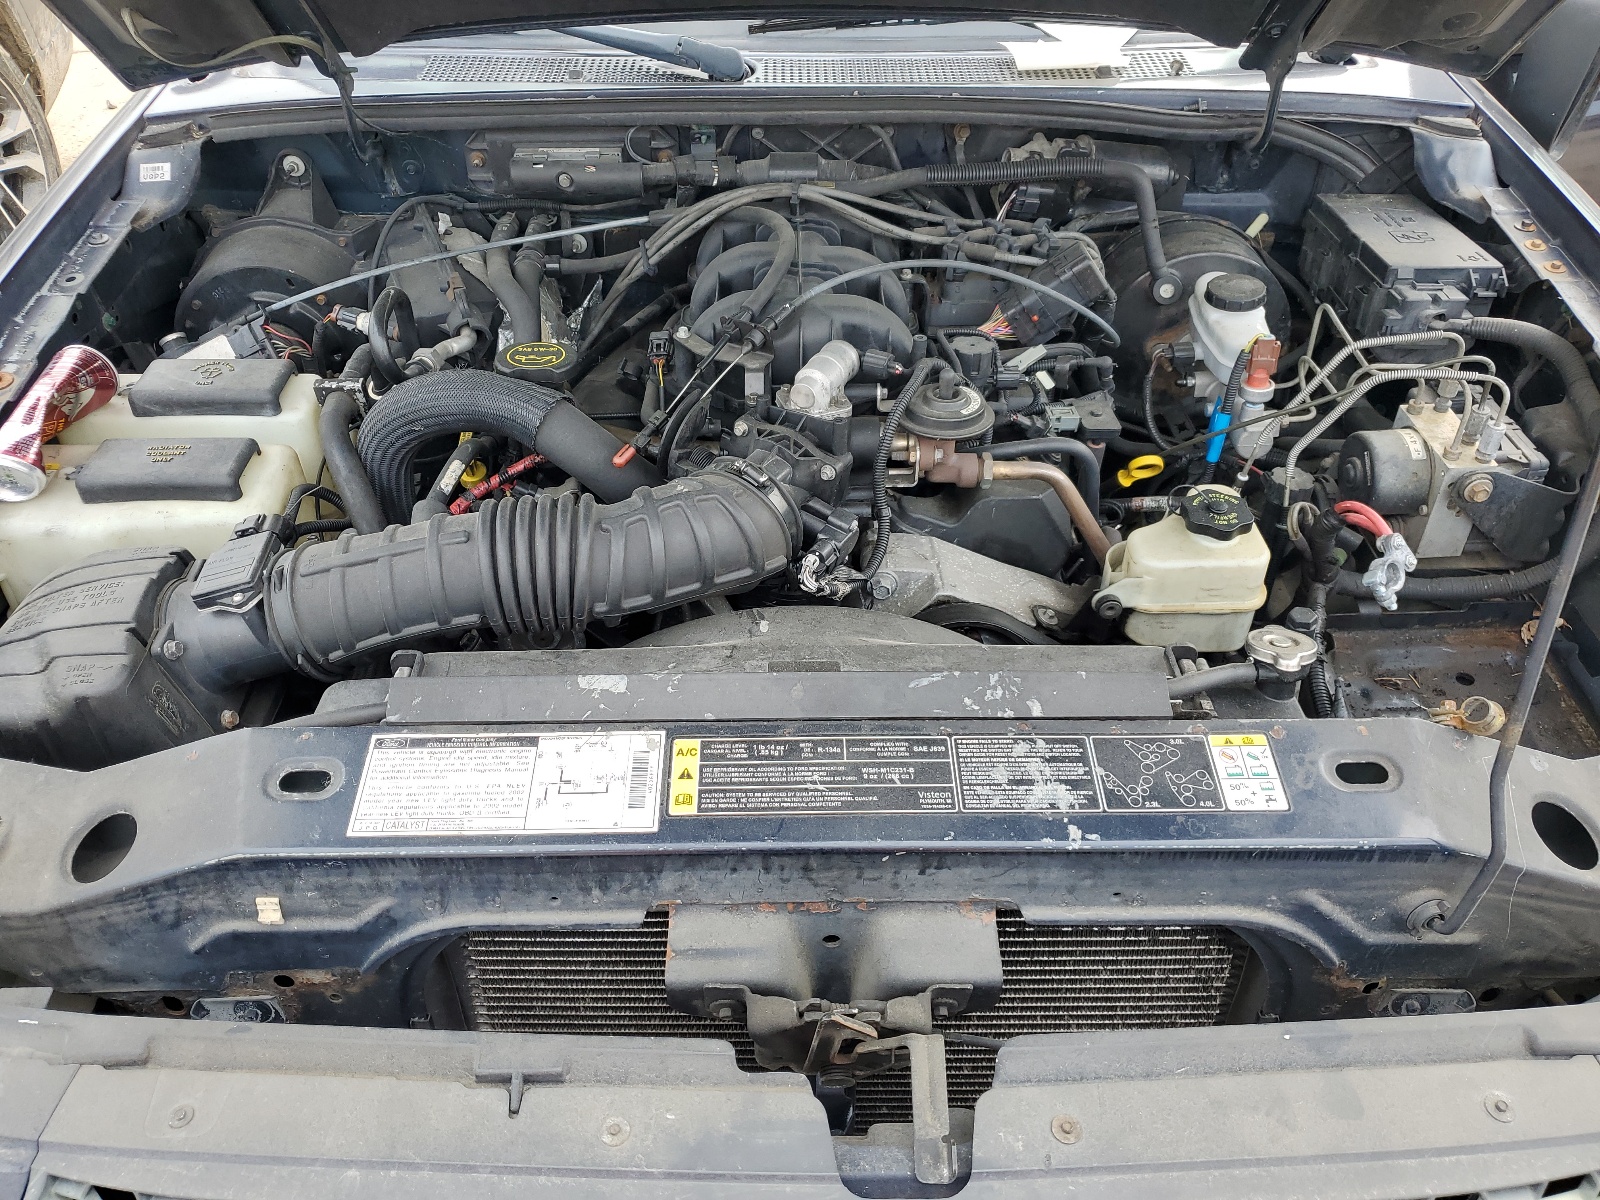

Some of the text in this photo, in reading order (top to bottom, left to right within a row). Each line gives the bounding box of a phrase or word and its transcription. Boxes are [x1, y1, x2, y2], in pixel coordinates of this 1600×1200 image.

[676, 748, 698, 757] A/C
[1230, 782, 1249, 790] 50%
[1235, 798, 1255, 806] 50%
[385, 821, 425, 830] CATALYST
